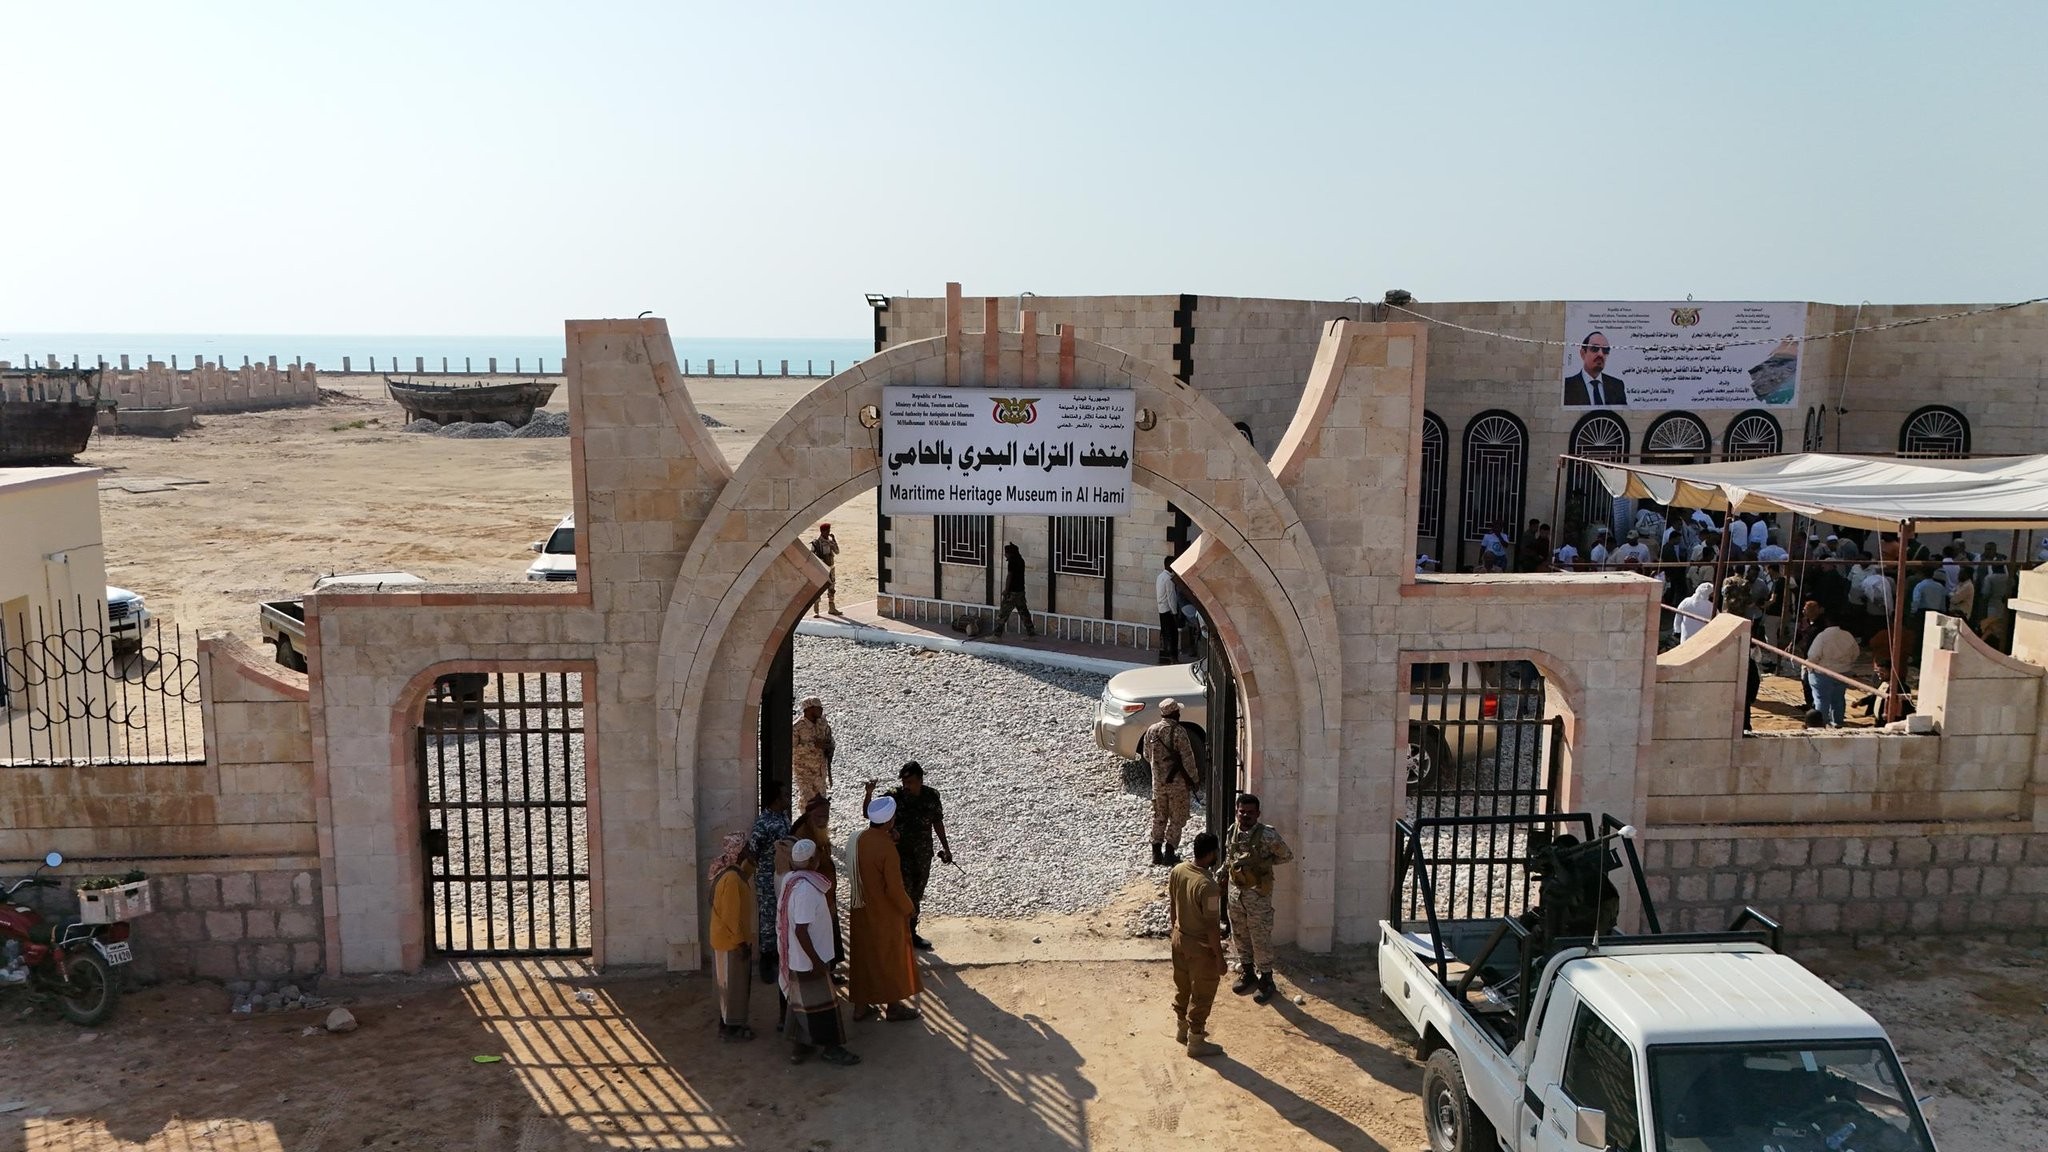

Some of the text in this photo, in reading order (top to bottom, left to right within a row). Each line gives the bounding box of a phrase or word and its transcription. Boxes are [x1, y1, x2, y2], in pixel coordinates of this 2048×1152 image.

[888, 440, 1129, 476] متحف التراث البحري بالحامي
[890, 484, 1124, 505] Maritime Heritage Museum in Al Hami
